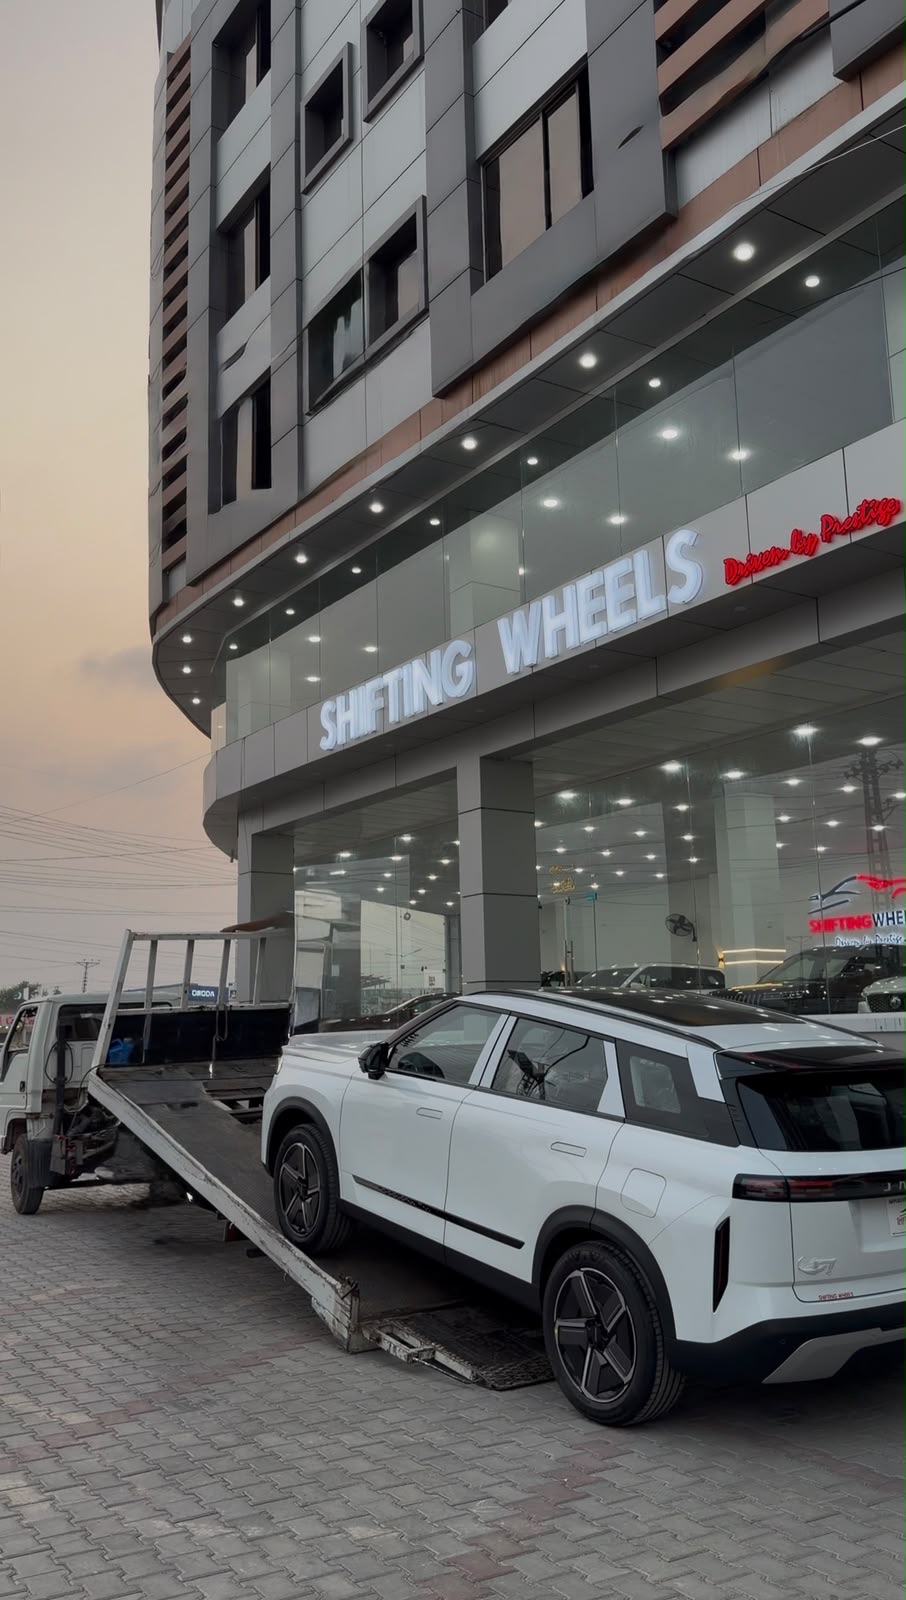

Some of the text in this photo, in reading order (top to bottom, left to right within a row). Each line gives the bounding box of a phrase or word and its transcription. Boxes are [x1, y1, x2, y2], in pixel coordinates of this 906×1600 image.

[723, 497, 901, 585] Driven by Prestige
[320, 530, 704, 752] SHIFTING WHEELS
